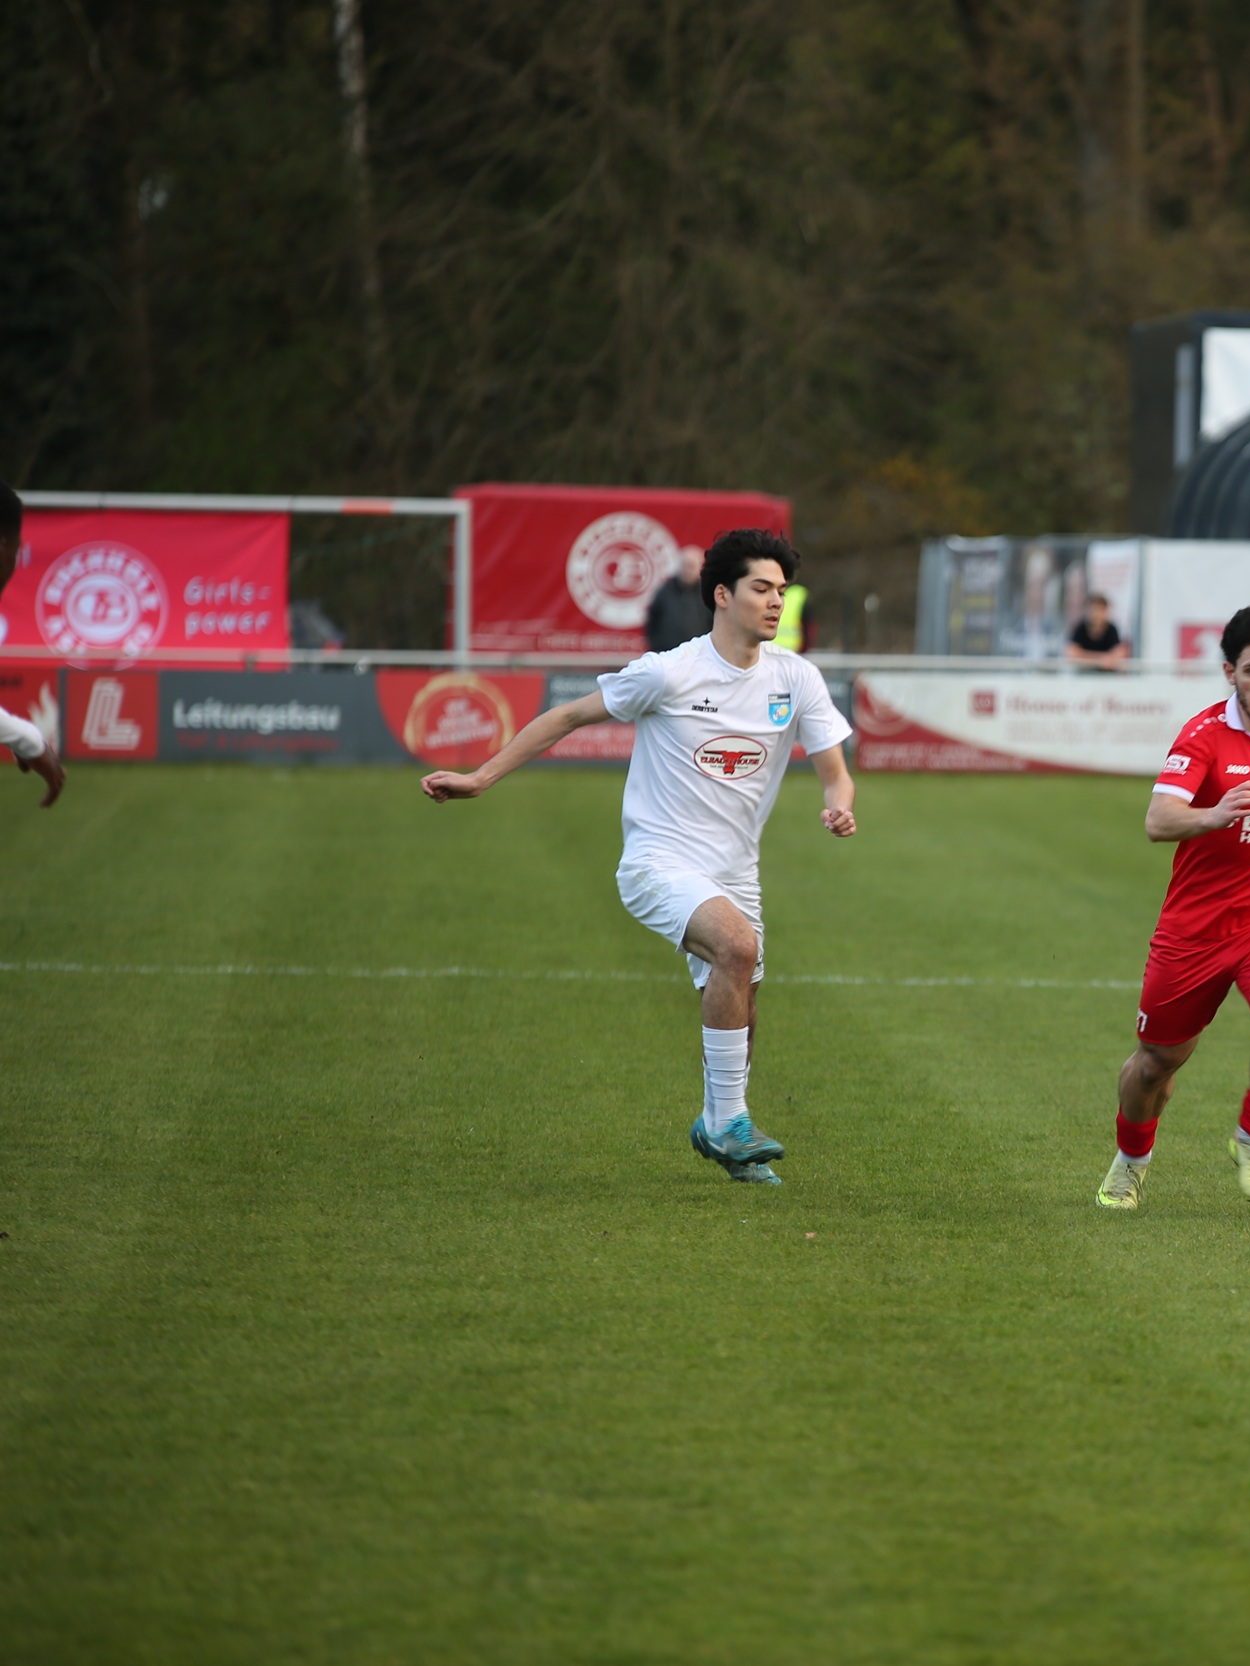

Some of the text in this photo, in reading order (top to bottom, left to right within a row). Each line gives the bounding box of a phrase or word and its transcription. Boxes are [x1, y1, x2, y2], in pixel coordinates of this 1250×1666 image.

[184, 577, 271, 606] Girls-
[184, 611, 271, 640] power
[173, 699, 341, 734] Leitungsbau
[1225, 764, 1250, 775] JAKO
